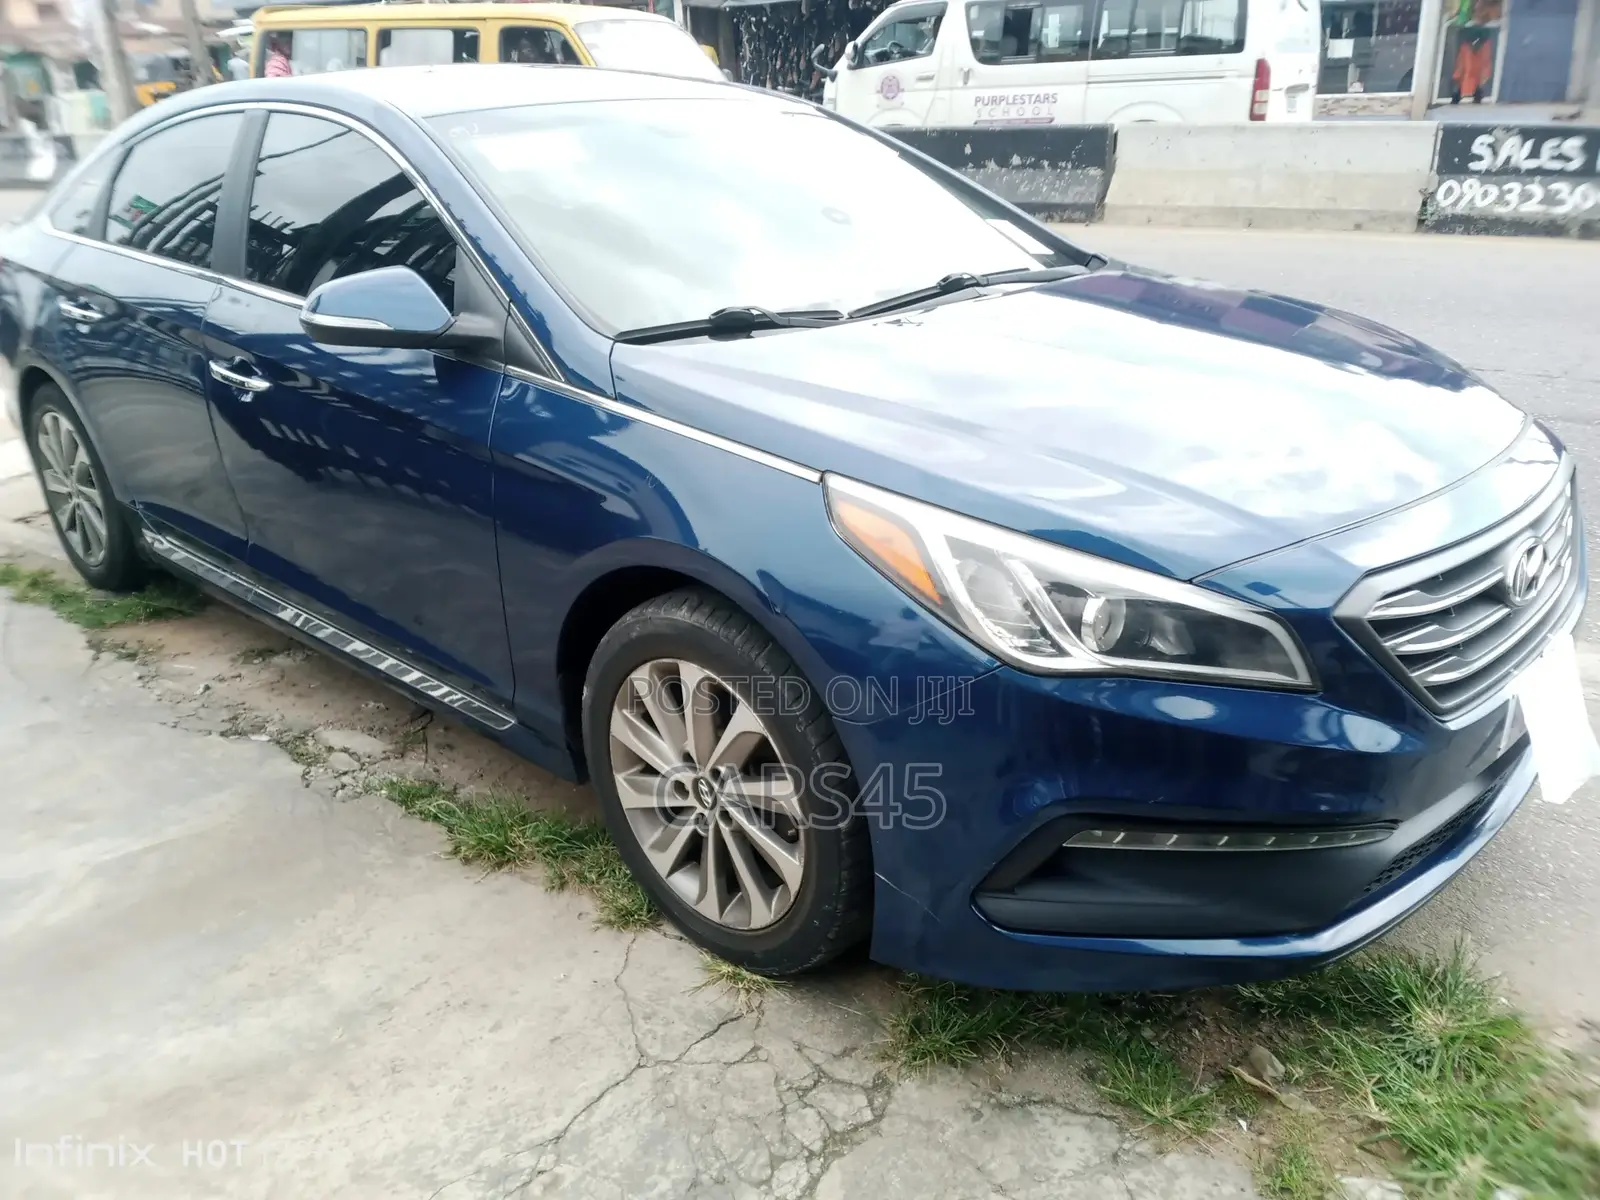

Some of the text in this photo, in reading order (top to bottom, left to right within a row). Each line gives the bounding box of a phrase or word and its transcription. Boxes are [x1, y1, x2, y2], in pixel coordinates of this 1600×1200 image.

[974, 93, 1058, 107] PURPLESTARS
[976, 106, 1053, 118] SCHOOL
[1467, 134, 1587, 172] SALES
[1436, 178, 1600, 214] 0903230
